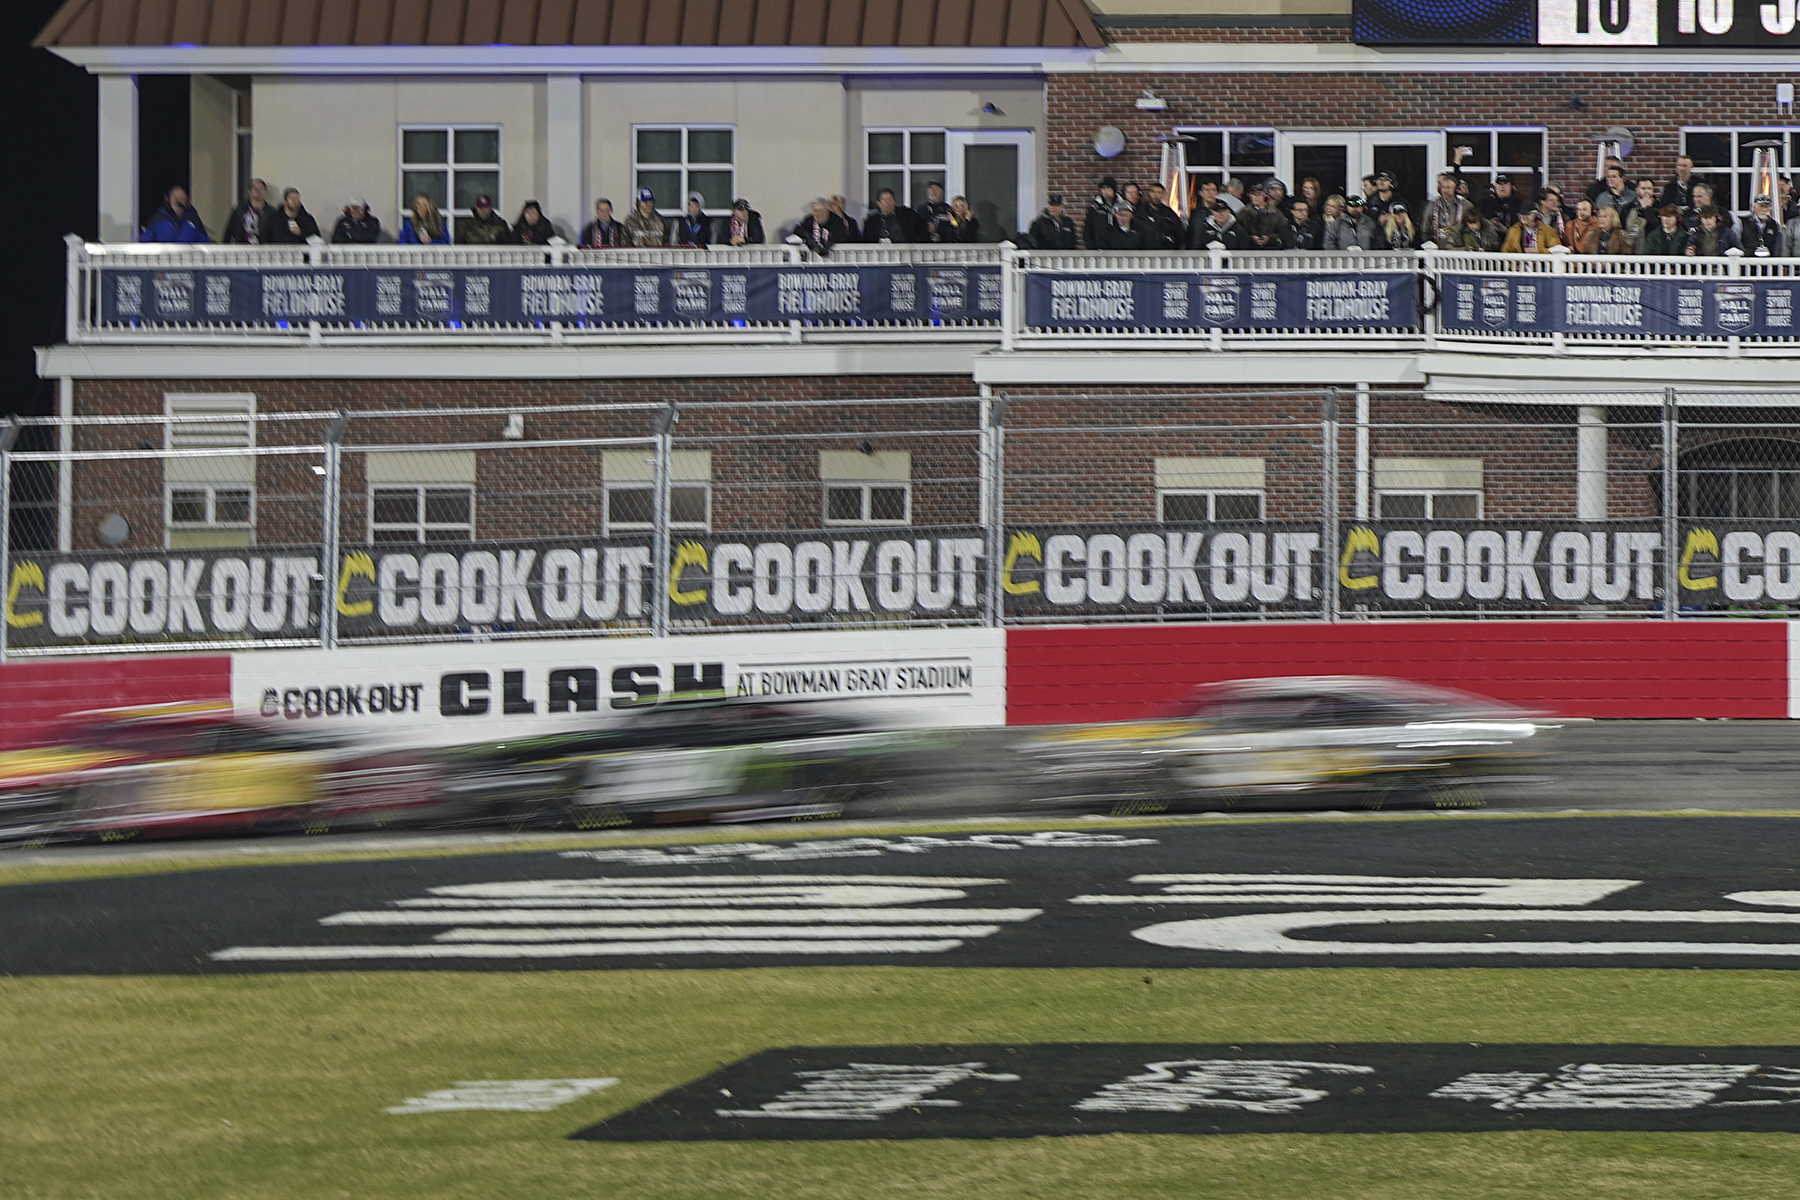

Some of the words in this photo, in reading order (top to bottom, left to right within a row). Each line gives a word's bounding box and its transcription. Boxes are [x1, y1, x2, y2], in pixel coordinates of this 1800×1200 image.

[417, 288, 447, 299] HALL
[675, 287, 704, 299] HALL
[932, 286, 962, 296] HALL
[1051, 280, 1134, 298] BOWMAN-GRAY
[1204, 292, 1233, 302] HALL
[1306, 281, 1388, 299] BOWMAN-GRAY
[1566, 285, 1641, 304] BOWMAN-GRAY
[416, 300, 449, 312] FAME
[676, 299, 708, 311] FAME
[1051, 297, 1135, 321] FIELDHOUSE
[1204, 304, 1235, 316] FAME
[1306, 298, 1389, 321] FIELDHOUSE
[1484, 296, 1504, 306] HALL
[1719, 300, 1749, 310] HALL
[1484, 308, 1506, 319] FAME
[1566, 303, 1642, 326] FIELDHOUSE
[1718, 313, 1750, 323] FAME
[1045, 533, 1205, 606] COOK
[1209, 532, 1320, 602] OUT
[1382, 530, 1543, 600] COOK
[1549, 531, 1662, 600] OUT
[711, 539, 871, 615] COOK
[876, 537, 986, 611] OUT
[378, 550, 539, 627] COOK
[541, 547, 652, 622] OUT
[48, 558, 206, 637] COOK
[211, 557, 318, 633] OUT
[440, 663, 726, 717] CLASH
[737, 673, 755, 698] AT
[761, 668, 842, 697] BOWMAN
[845, 667, 892, 692] GRAY
[895, 665, 972, 690] STADIUM
[283, 684, 366, 720] COOK
[368, 682, 424, 714] OUT
